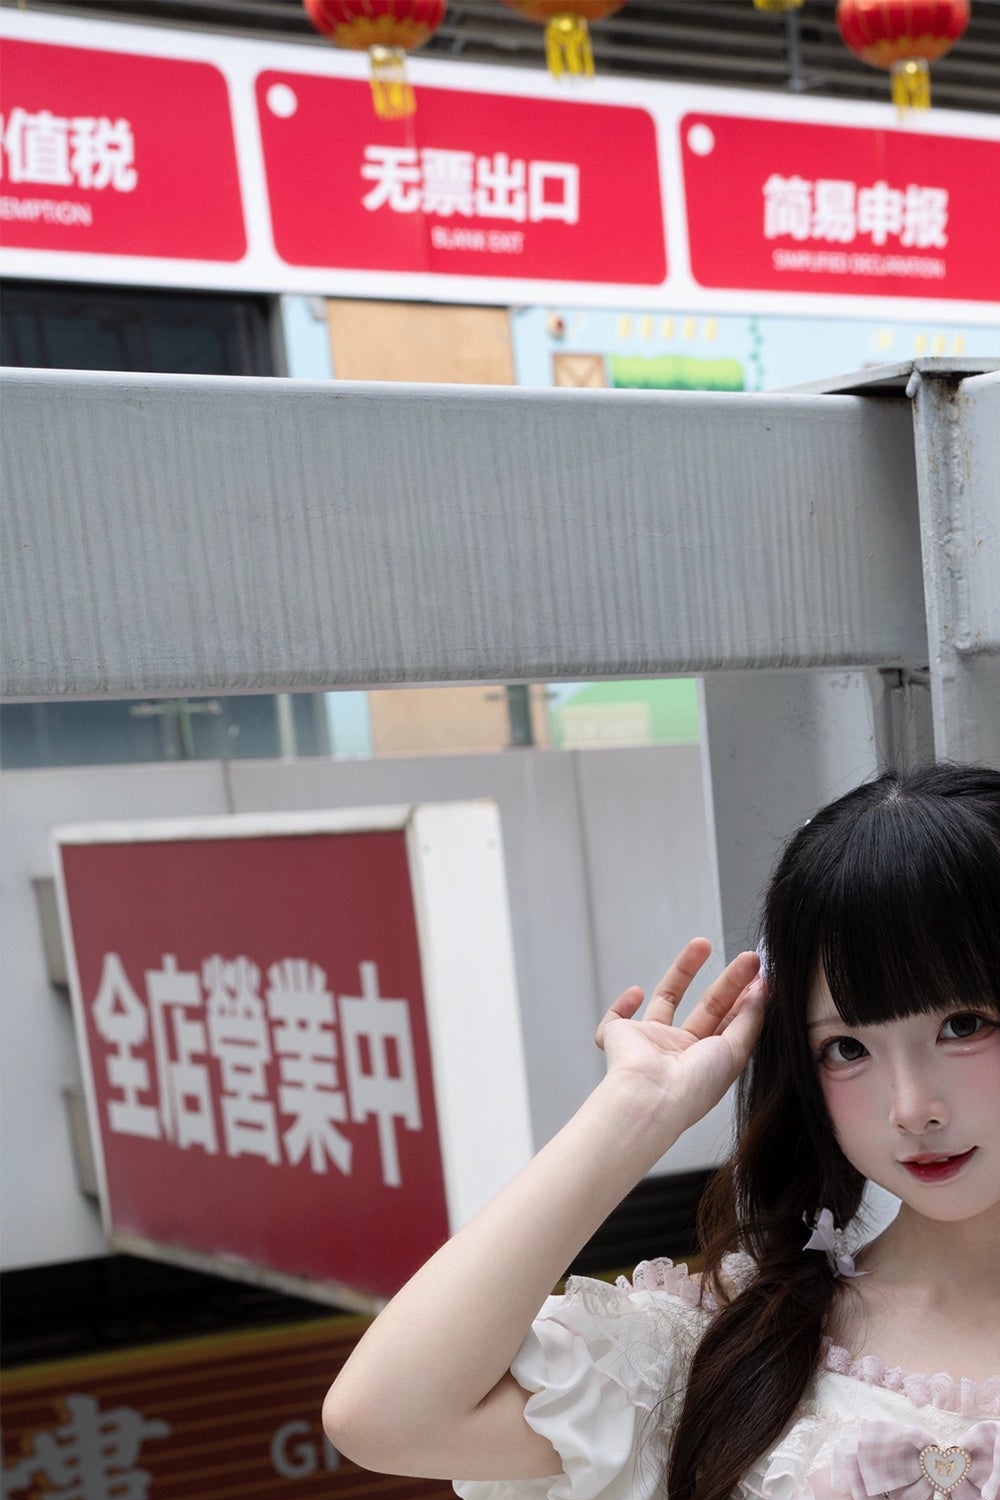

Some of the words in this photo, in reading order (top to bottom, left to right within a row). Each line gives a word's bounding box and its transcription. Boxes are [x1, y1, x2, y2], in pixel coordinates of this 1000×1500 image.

[0, 106, 138, 193] 值税
[360, 144, 580, 226] 无票出口
[762, 173, 949, 249] 简易申报
[92, 952, 423, 1189] 全店營業中
